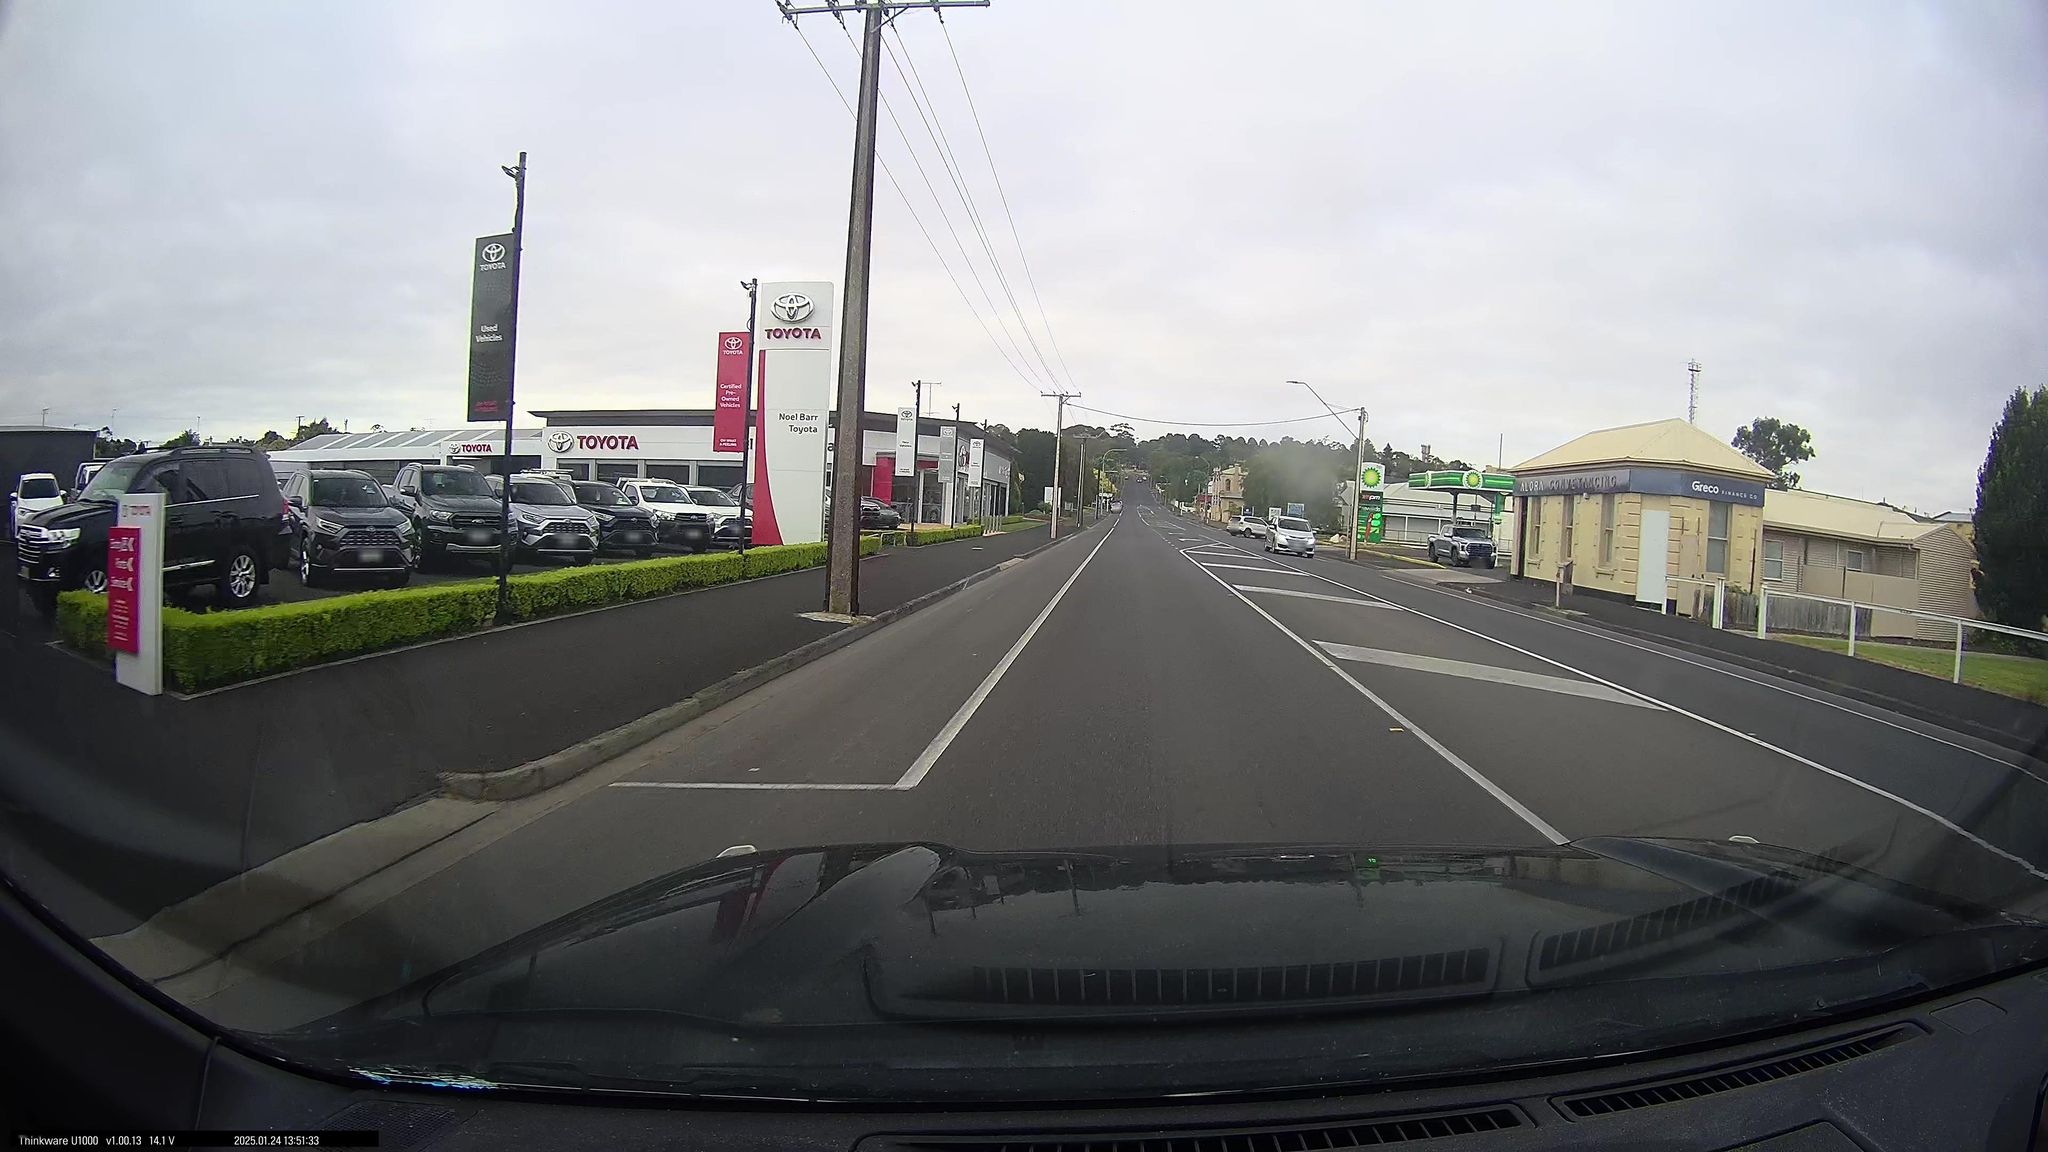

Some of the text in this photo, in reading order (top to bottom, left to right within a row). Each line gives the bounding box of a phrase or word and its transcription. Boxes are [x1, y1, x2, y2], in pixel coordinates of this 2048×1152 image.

[480, 262, 507, 272] TOYOTA
[480, 323, 498, 333] Used
[475, 333, 503, 343] Vehicles
[764, 327, 822, 340] TOYOTA
[778, 413, 818, 421] Noel Barr
[788, 424, 818, 434] Toyota
[461, 443, 493, 453] TOYOTA
[577, 436, 640, 450] TOYOTA
[1519, 475, 1617, 492] ALORA CONVEYANCING
[1691, 480, 1720, 495] Greco
[1721, 490, 1748, 499] FINANCE
